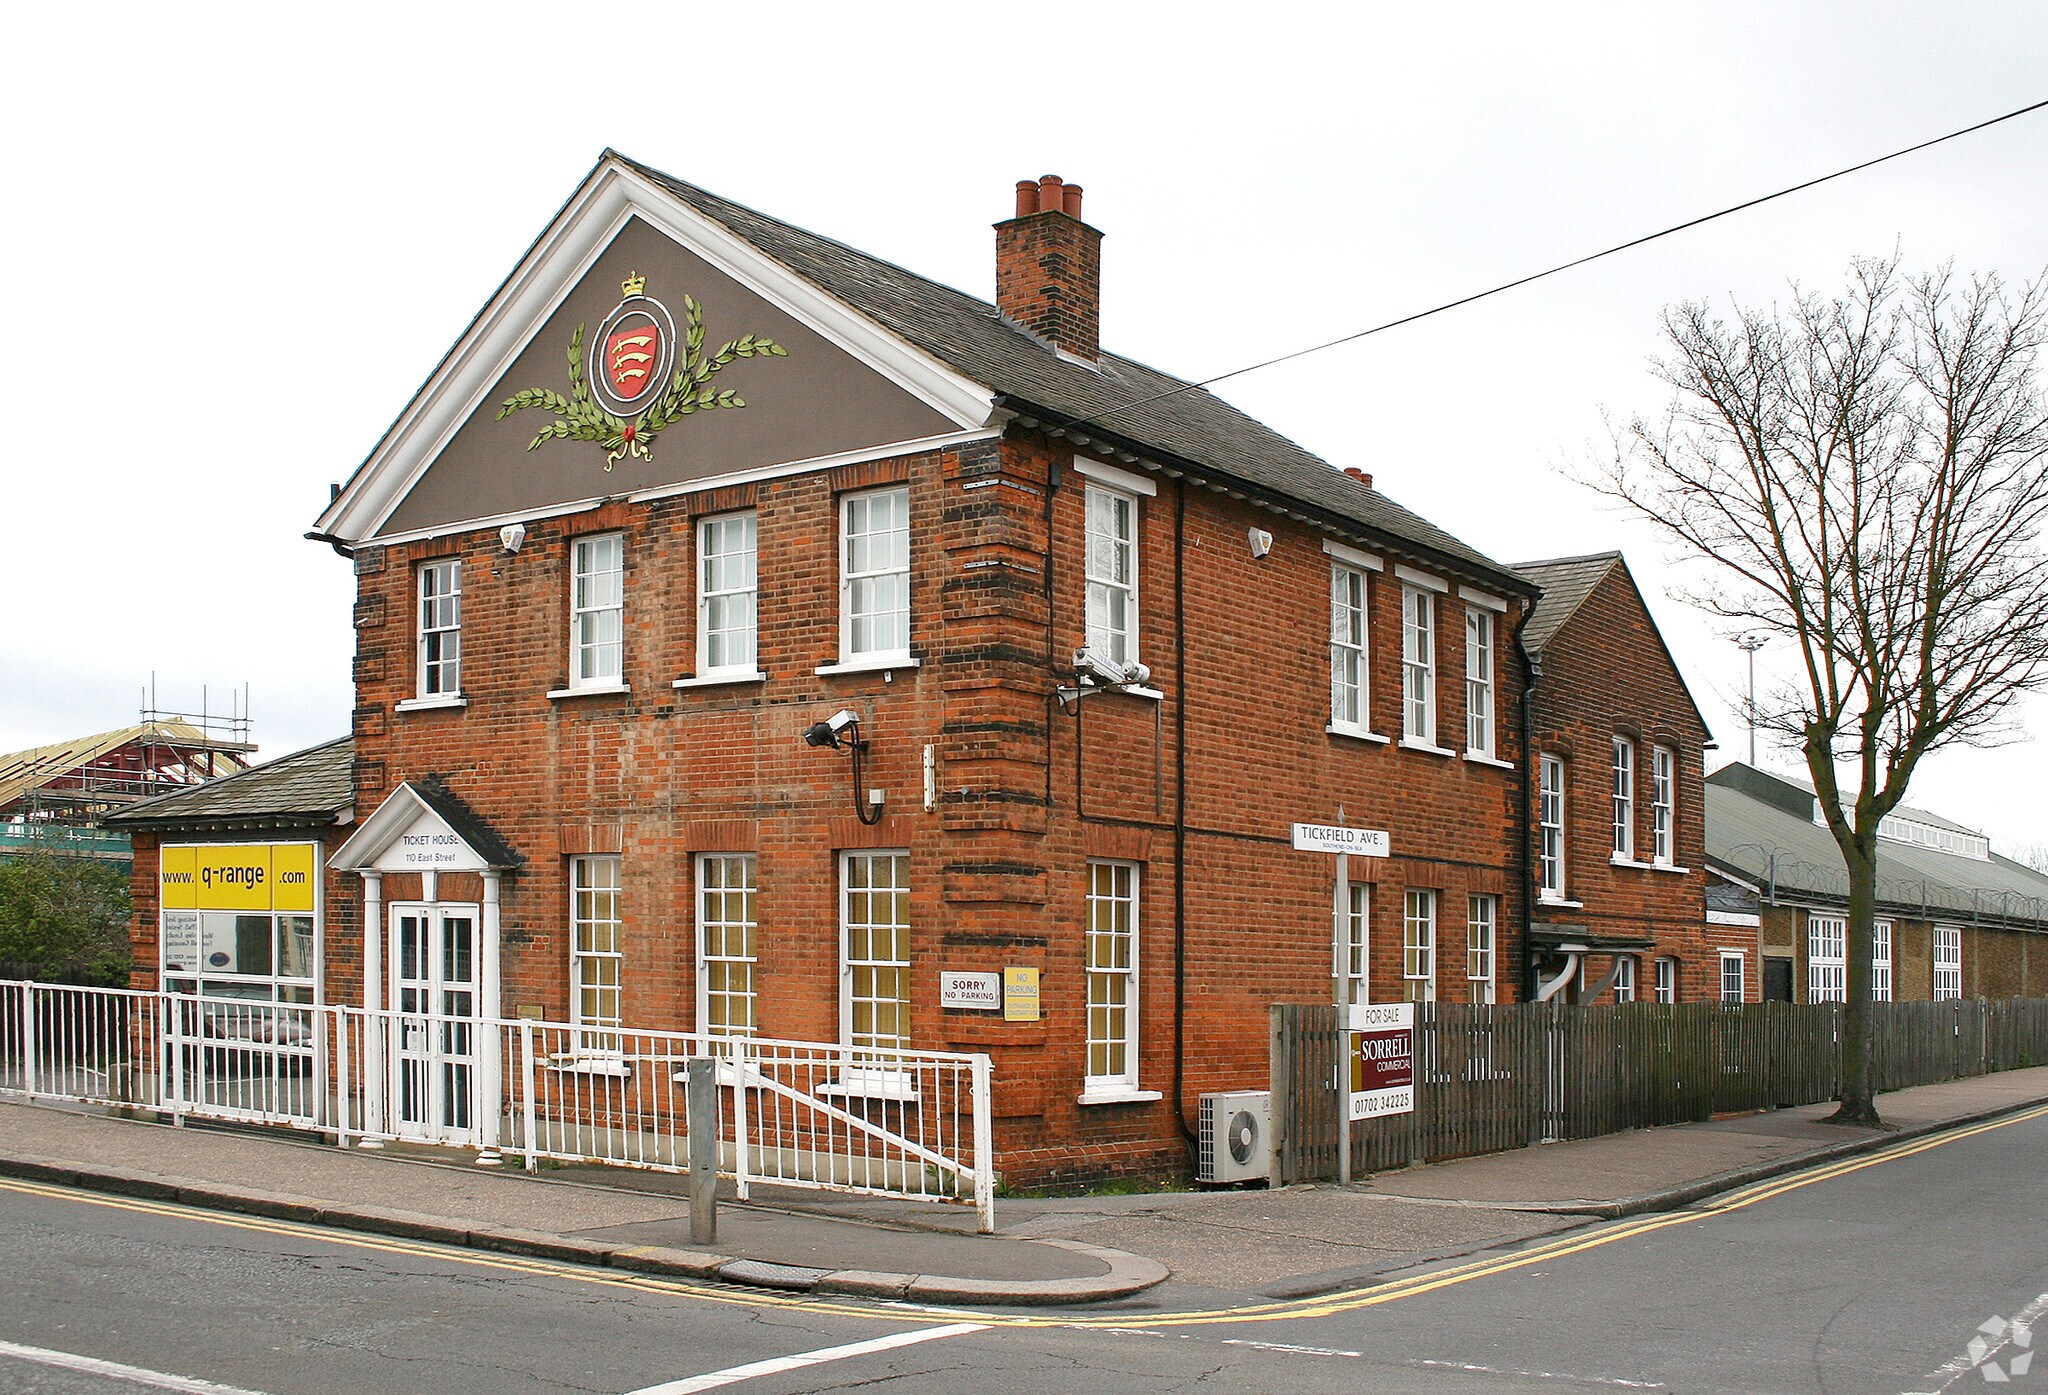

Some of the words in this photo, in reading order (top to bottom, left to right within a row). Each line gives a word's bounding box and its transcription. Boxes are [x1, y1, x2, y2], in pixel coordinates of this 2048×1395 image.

[403, 836, 429, 845] TICKET
[1301, 827, 1354, 842] TICKFIELD
[1359, 833, 1382, 845] AVE.
[434, 853, 455, 861] Street
[163, 873, 194, 883] www.
[202, 866, 264, 889] q-range
[279, 870, 305, 883] .com
[1016, 974, 1027, 982] NO
[952, 981, 986, 990] SORRY
[1006, 986, 1037, 994] PARKING
[961, 992, 994, 1000] PARKING
[1365, 1010, 1381, 1023] FOR
[1383, 1008, 1399, 1022] SALE
[1361, 1038, 1410, 1060] SORRELL
[1376, 1060, 1410, 1072] COMMERCIAL
[1354, 1098, 1378, 1113] 01702
[1380, 1093, 1409, 1109] 342225
